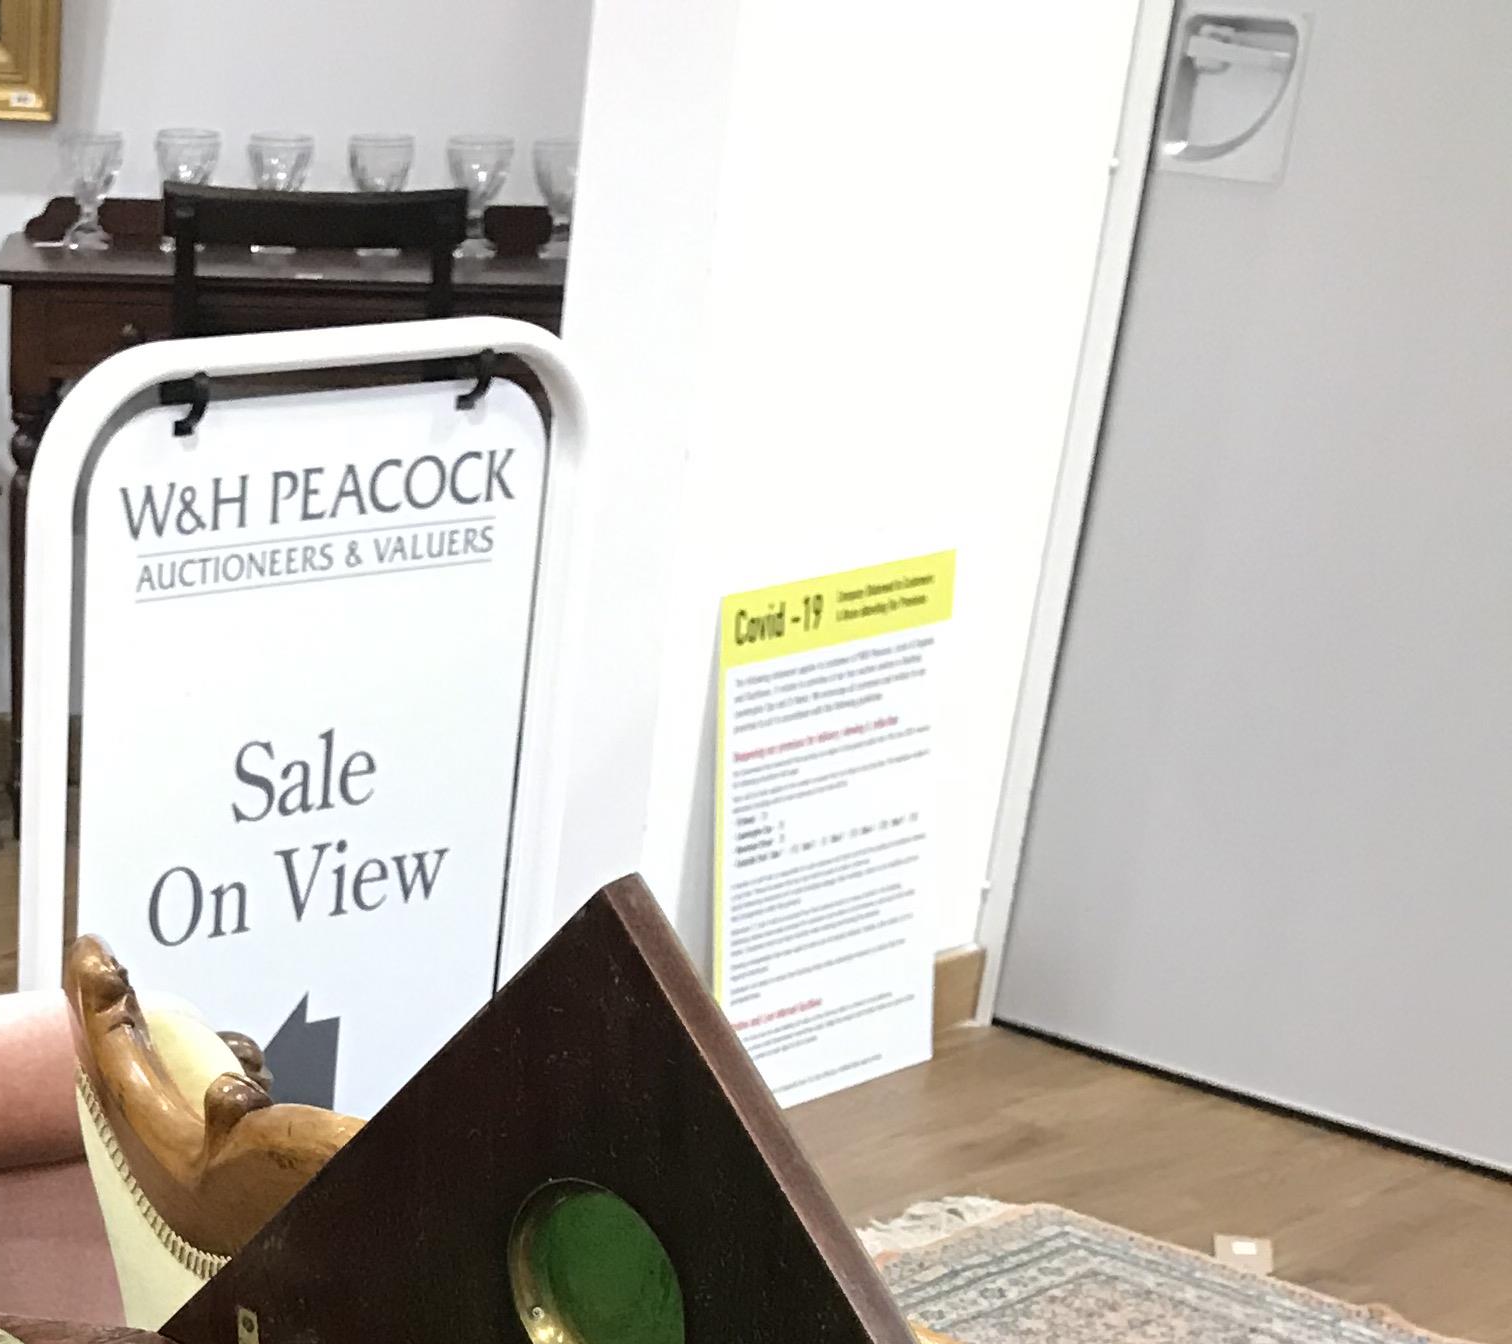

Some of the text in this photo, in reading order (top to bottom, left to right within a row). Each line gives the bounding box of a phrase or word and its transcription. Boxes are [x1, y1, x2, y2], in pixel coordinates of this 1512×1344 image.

[120, 448, 514, 540] W&H PEACOCK
[137, 526, 494, 592] AUCTIONEERS & VALUERS
[735, 601, 785, 645] Covid
[232, 728, 376, 823] Sale
[148, 840, 449, 946] On View
